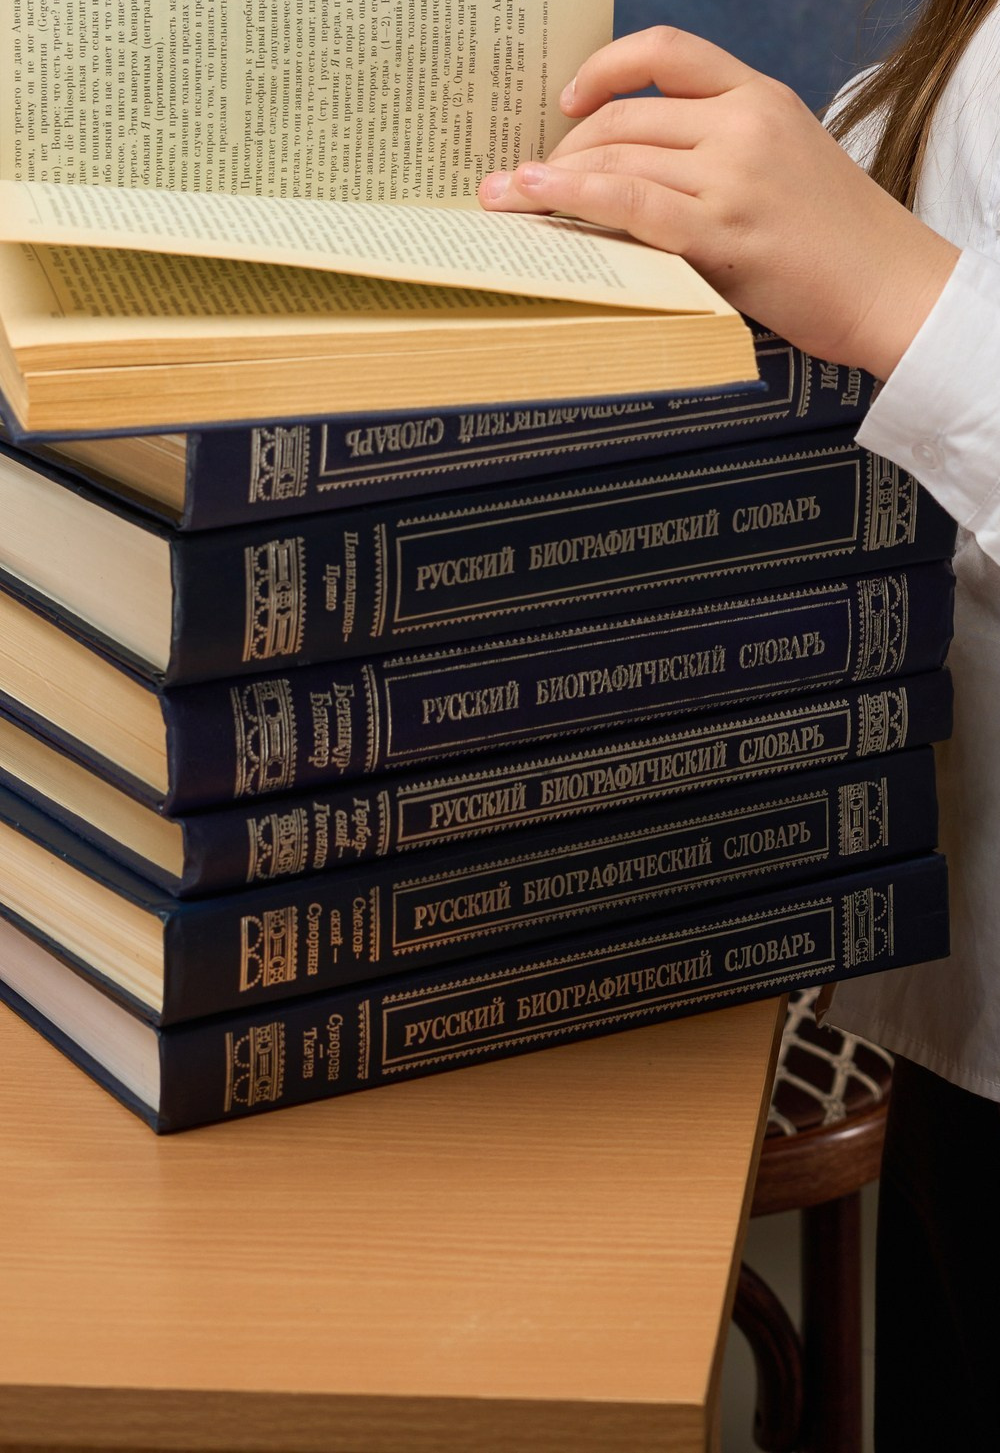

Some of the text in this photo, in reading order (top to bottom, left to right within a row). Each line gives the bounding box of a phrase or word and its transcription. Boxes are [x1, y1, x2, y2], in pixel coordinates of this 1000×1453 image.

[64, 2, 74, 36] reinen
[182, 4, 192, 55] пределах
[467, 4, 478, 74] квазиученый
[14, 38, 23, 65] дано
[64, 41, 74, 60] der
[254, 26, 267, 69] Первый
[517, 42, 525, 72] делит
[40, 43, 51, 134] противопонятия
[64, 65, 76, 128] Philosophie
[79, 65, 87, 102] нельзя
[131, 51, 141, 103] вывертом
[245, 69, 255, 104] теперь
[282, 69, 290, 129] отношении
[405, 44, 415, 112] возможность
[491, 91, 500, 112] еще
[15, 87, 25, 134] третьего
[79, 109, 87, 154] понятие
[128, 107, 138, 136] Этим
[219, 96, 229, 153] пределами
[64, 134, 74, 151] die
[156, 129, 166, 188] вторичным
[240, 110, 254, 189] Присмотримся
[281, 133, 289, 163] таком
[402, 118, 413, 184] открывается
[464, 110, 473, 170] принимают
[218, 159, 226, 191] этими
[463, 177, 472, 196] рые
[346, 416, 445, 457] СЛОВАРЬ
[416, 496, 820, 590] РУССКИЙ БИОГРАФИЧЕСКИЙ СЛОВАРЬ
[323, 564, 341, 611] Примо
[423, 632, 824, 723] РУССКИЙ БИОГРАФИЧЕСКИЙ СЛОВАРЬ
[431, 725, 824, 828] РУССКИЙ БИОГРАФИЧЕСКИЙ СЛОВАРЬ
[415, 822, 810, 929] РУССКИЙ БИОГРАФИЧЕСКИЙ СЛОВАРЬ
[306, 903, 322, 976] Суворина
[405, 933, 814, 1046] РУССКИЙ БИОГРАФИЧЕСКИЙ СЛОВАРЬ
[303, 1027, 317, 1079] Ткачев
[326, 1014, 343, 1081] Суворова
